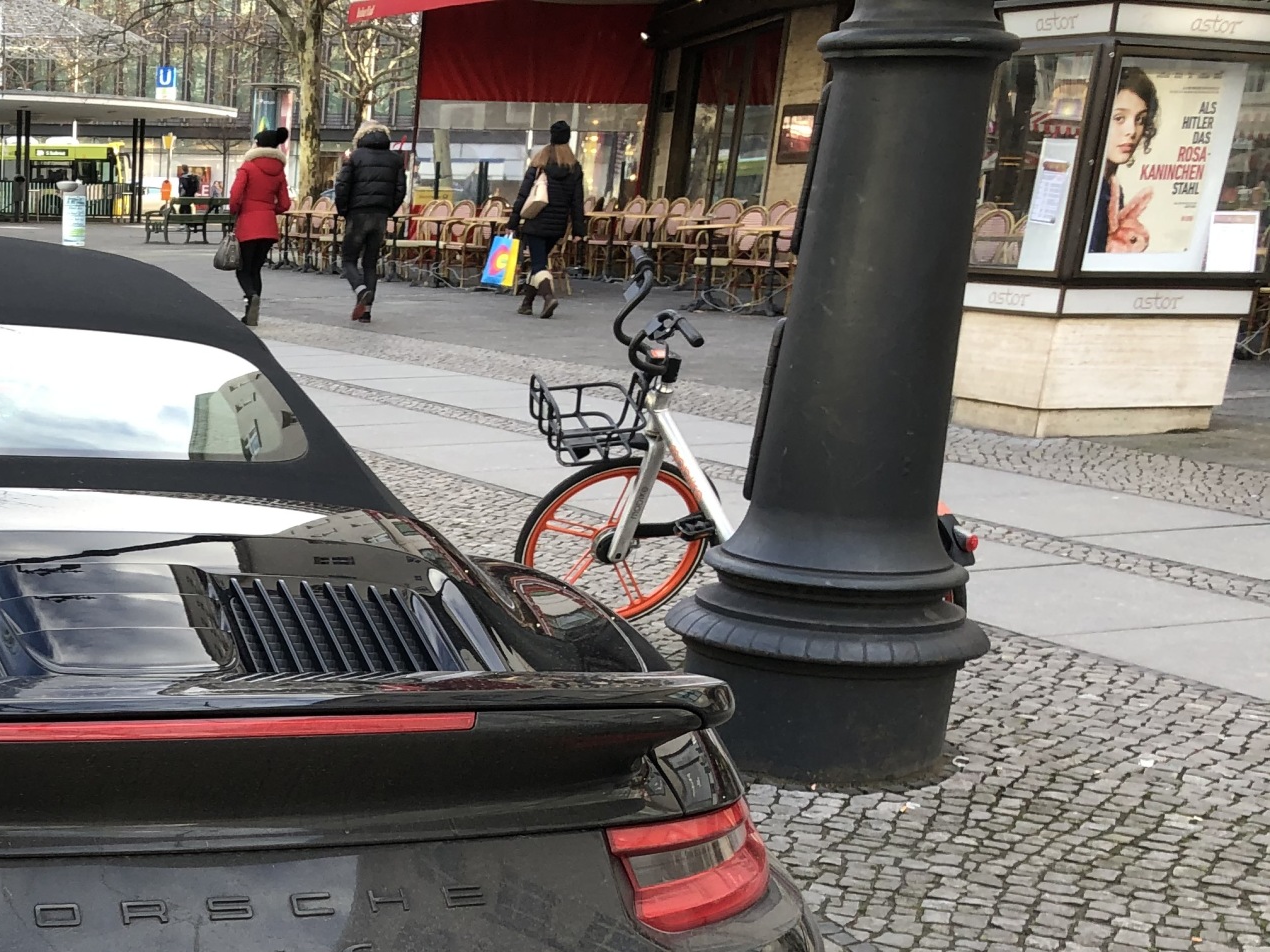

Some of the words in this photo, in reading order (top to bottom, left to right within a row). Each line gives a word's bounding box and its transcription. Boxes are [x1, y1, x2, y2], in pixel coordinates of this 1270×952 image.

[1035, 13, 1079, 32] astor
[1191, 15, 1243, 35] astor
[159, 68, 172, 86] U
[1198, 101, 1218, 115] ALS
[1181, 116, 1214, 130] HITLER
[1192, 131, 1211, 145] DAS
[1177, 146, 1212, 162] ROSA-
[1139, 164, 1205, 181] KANINCHEN
[1172, 182, 1200, 195] STAHL
[987, 288, 1031, 307] astor
[1132, 289, 1184, 310] astor
